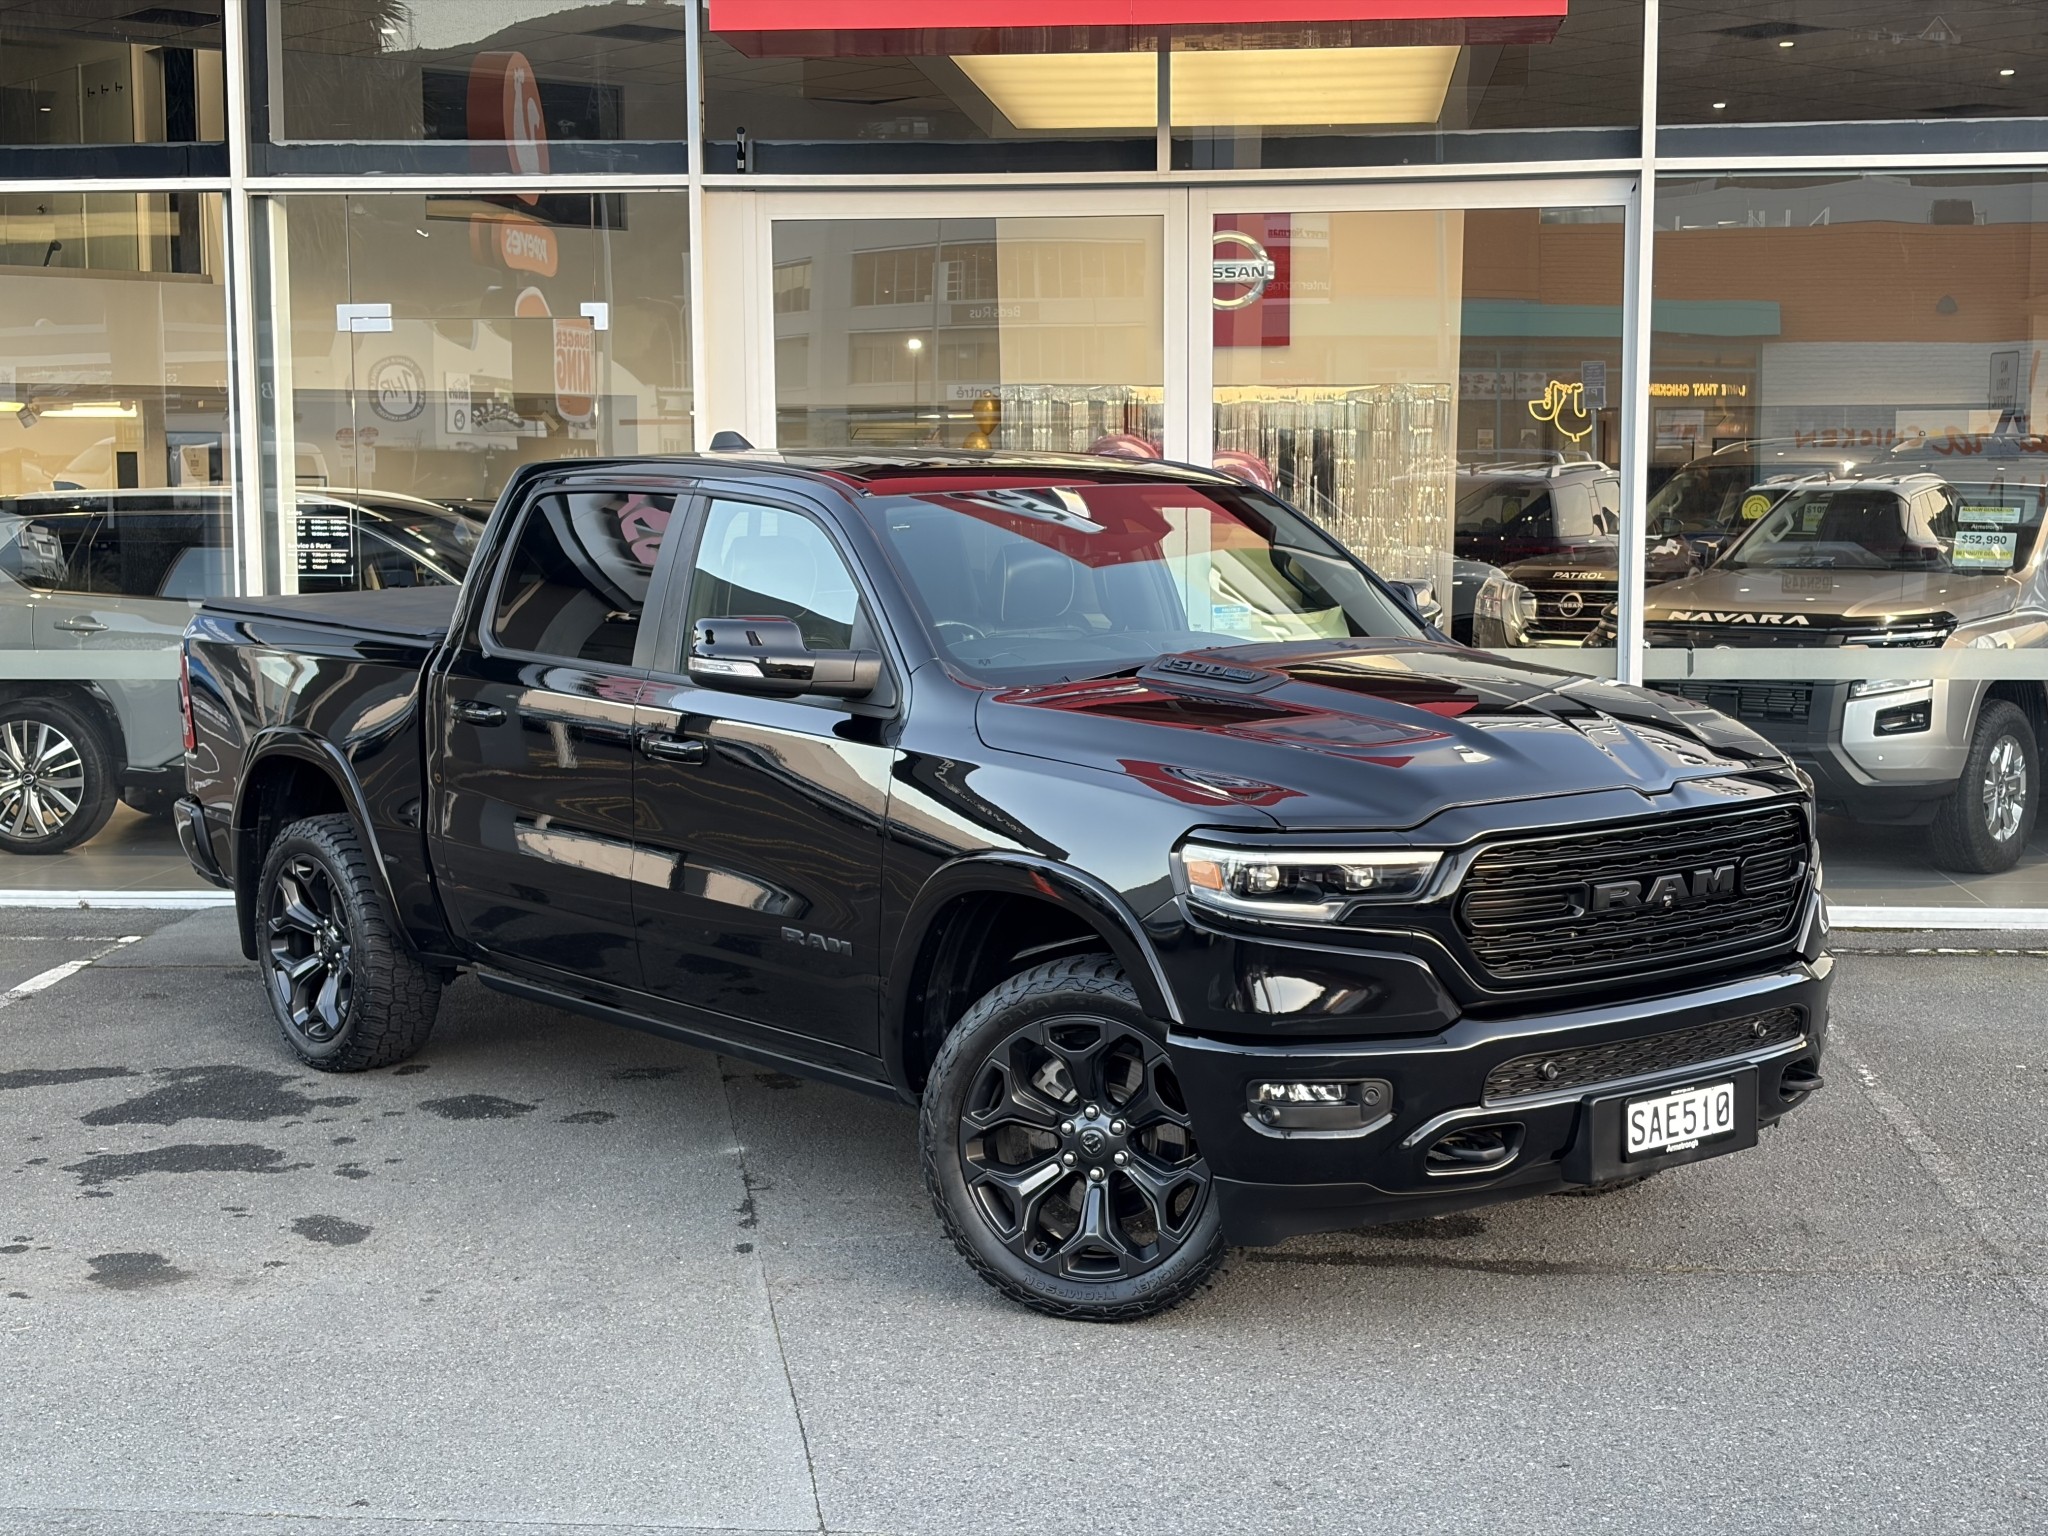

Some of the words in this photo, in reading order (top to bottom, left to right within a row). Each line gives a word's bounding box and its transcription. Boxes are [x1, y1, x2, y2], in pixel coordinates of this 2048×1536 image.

[1961, 535, 2007, 546] $52,990
[1552, 571, 1606, 579] PATROL
[1667, 611, 1810, 626] NAVARA
[1164, 658, 1227, 677] 1500
[1593, 865, 1735, 911] RAM
[781, 926, 853, 957] RAM
[1631, 1091, 1730, 1146] SAE510
[1023, 1273, 1118, 1301] THOMPSON
